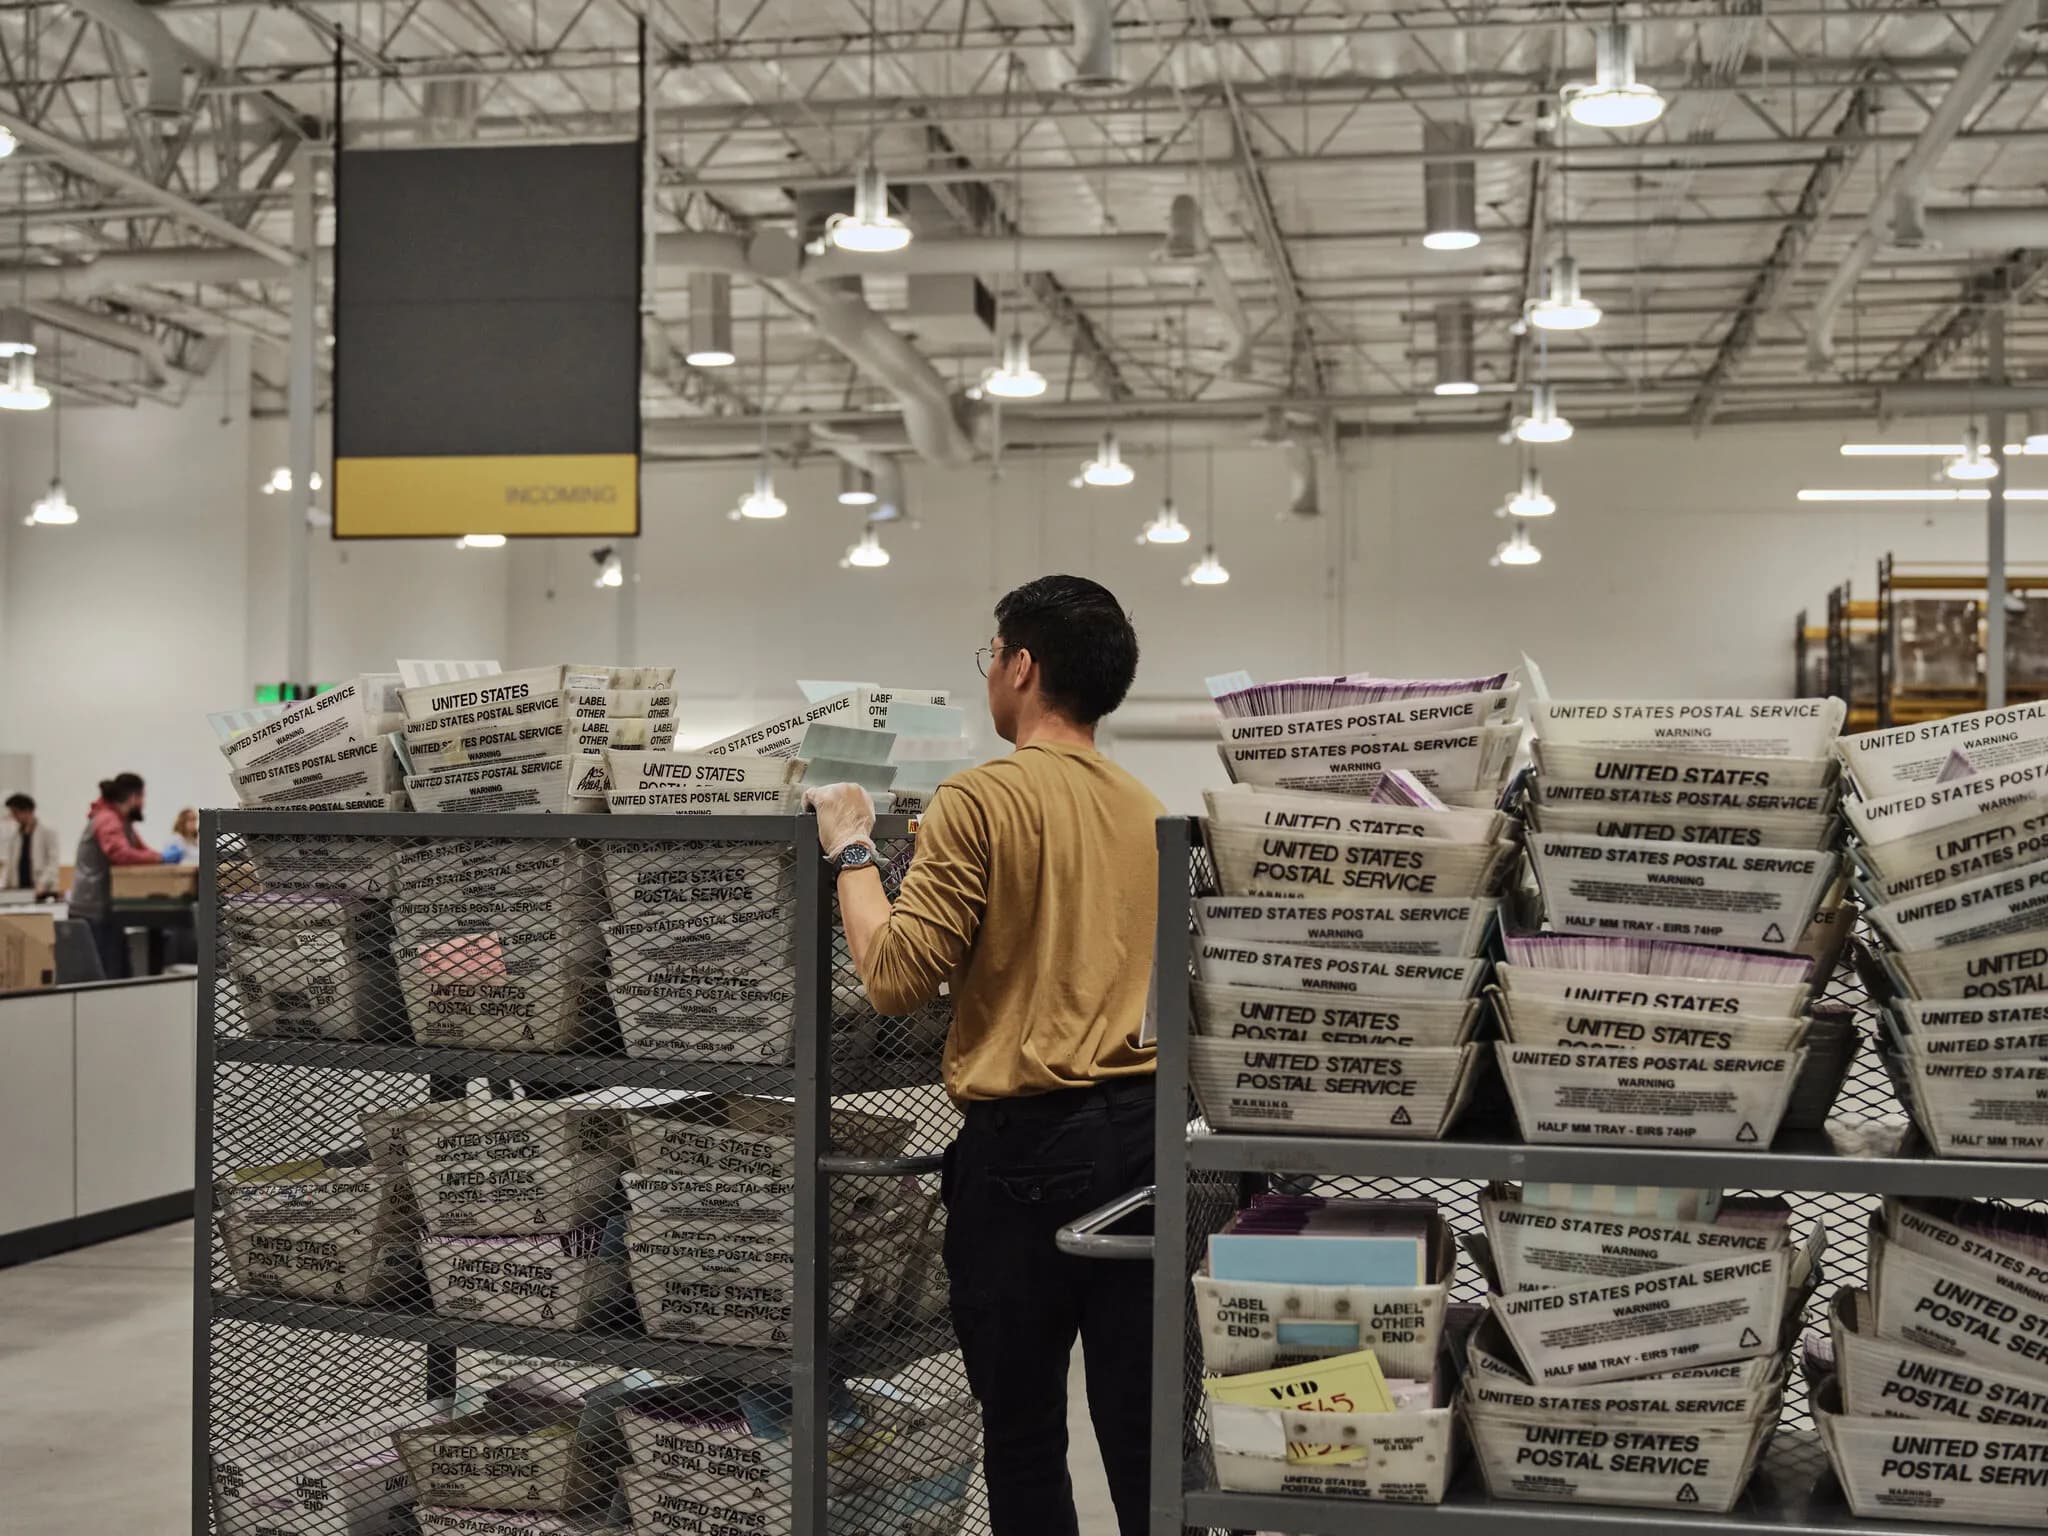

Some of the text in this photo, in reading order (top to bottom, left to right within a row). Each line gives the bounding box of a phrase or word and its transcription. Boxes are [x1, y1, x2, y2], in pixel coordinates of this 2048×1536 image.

[505, 485, 617, 504] INCOMING
[432, 684, 529, 712] UNITED STATES
[579, 696, 607, 706] LABEL
[650, 697, 670, 706] LABEL
[408, 698, 559, 734] UNITED STATES POSTAL SERVICE
[576, 708, 605, 718] OTHER
[648, 709, 670, 718] OTHER
[1550, 704, 1821, 719] UNITED STATES POSTAL SERVICE
[226, 738, 252, 756] UNITED
[253, 722, 282, 743] STATES
[282, 706, 316, 729] POSTAL
[316, 686, 356, 712] SERVICE
[582, 723, 610, 732] LABEL
[653, 723, 673, 732] LABEL
[728, 731, 764, 752] STATES
[766, 717, 804, 737] POSTAL
[806, 698, 850, 722] SERVICE
[1232, 703, 1474, 740] UNITED STATES POSTAL SERVICE
[1860, 706, 2045, 750] UNITED STATES POSTAL
[275, 727, 305, 746] WARNING
[579, 736, 608, 744] OTHER
[650, 736, 672, 744] OTHER
[1654, 728, 1712, 738] WARNING
[1963, 732, 2018, 750] WARNING
[756, 737, 790, 756] WARNING
[468, 752, 502, 761] WARNING
[410, 777, 442, 790] UNITED
[444, 774, 480, 785] STATES
[481, 767, 520, 780] POSTAL
[520, 760, 562, 774] SERVICE
[643, 762, 745, 782] UNITED STATES
[1330, 762, 1382, 773] WARNING
[1594, 762, 1770, 787] UNITED STATES
[293, 773, 323, 786] WARNING
[470, 784, 503, 795] WARNING
[612, 790, 779, 806] UNITED STATES POSTAL SERVICE
[1866, 778, 1994, 820] UNITED STATES
[1262, 839, 1424, 869] UNITED STATES
[1544, 844, 1815, 874] UNITED STATES POSTAL SERVICE
[1253, 862, 1437, 893] POSTAL SERVICE
[1646, 874, 1705, 886] WARNING
[1566, 916, 1596, 926] HALF
[1599, 917, 1620, 928] MM
[1622, 920, 1654, 930] TRAY
[1663, 922, 1690, 934] EIRS
[1308, 929, 1364, 940] WARNING
[1302, 978, 1358, 992] WARNING
[1922, 1012, 1984, 1026] UNITED
[1244, 1051, 1403, 1076] UNITED STATES
[1236, 1072, 1417, 1098] POSTAL SERVICE
[1618, 1077, 1676, 1089] WARNING
[1538, 1121, 1568, 1132] HALF
[1571, 1122, 1592, 1133] MM
[1595, 1124, 1626, 1134] TRAY
[1636, 1125, 1664, 1136] EIRS
[1951, 1135, 2044, 1147] HALF MM TRAY
[1499, 1210, 1768, 1250] UNITED STATES POSTAL SERVICE
[1901, 1213, 2025, 1274] UNITED STATES
[1601, 1244, 1658, 1260] WARNING
[1507, 1296, 1564, 1315] UNITED
[1568, 1282, 1630, 1306] STATES
[1634, 1274, 1698, 1295] POSTAL
[1703, 1260, 1772, 1283] SERVICE
[1219, 1298, 1268, 1312] LABEL
[1373, 1303, 1424, 1316] LABEL
[1613, 1300, 1670, 1317] WARNING
[1217, 1310, 1270, 1324] OTHER
[1371, 1316, 1425, 1330] OTHER
[1228, 1325, 1260, 1338] END
[1382, 1331, 1416, 1344] END
[1544, 1364, 1574, 1378] HALF
[1578, 1360, 1598, 1374] MM
[1600, 1356, 1632, 1370] TRAY
[1642, 1350, 1668, 1363] EIRS
[1270, 1380, 1319, 1400] VCD
[1881, 1380, 1970, 1418] POSTAL
[1526, 1426, 1700, 1452] UNITED STATES
[1892, 1436, 1979, 1458] UNITED
[1516, 1449, 1709, 1476] POSTAL SERVICE
[1882, 1460, 1973, 1482] POSTAL
[1284, 1475, 1366, 1486] UNITED STATES
[1281, 1484, 1323, 1494] POSTAL
[1325, 1486, 1372, 1496] SERVICE
